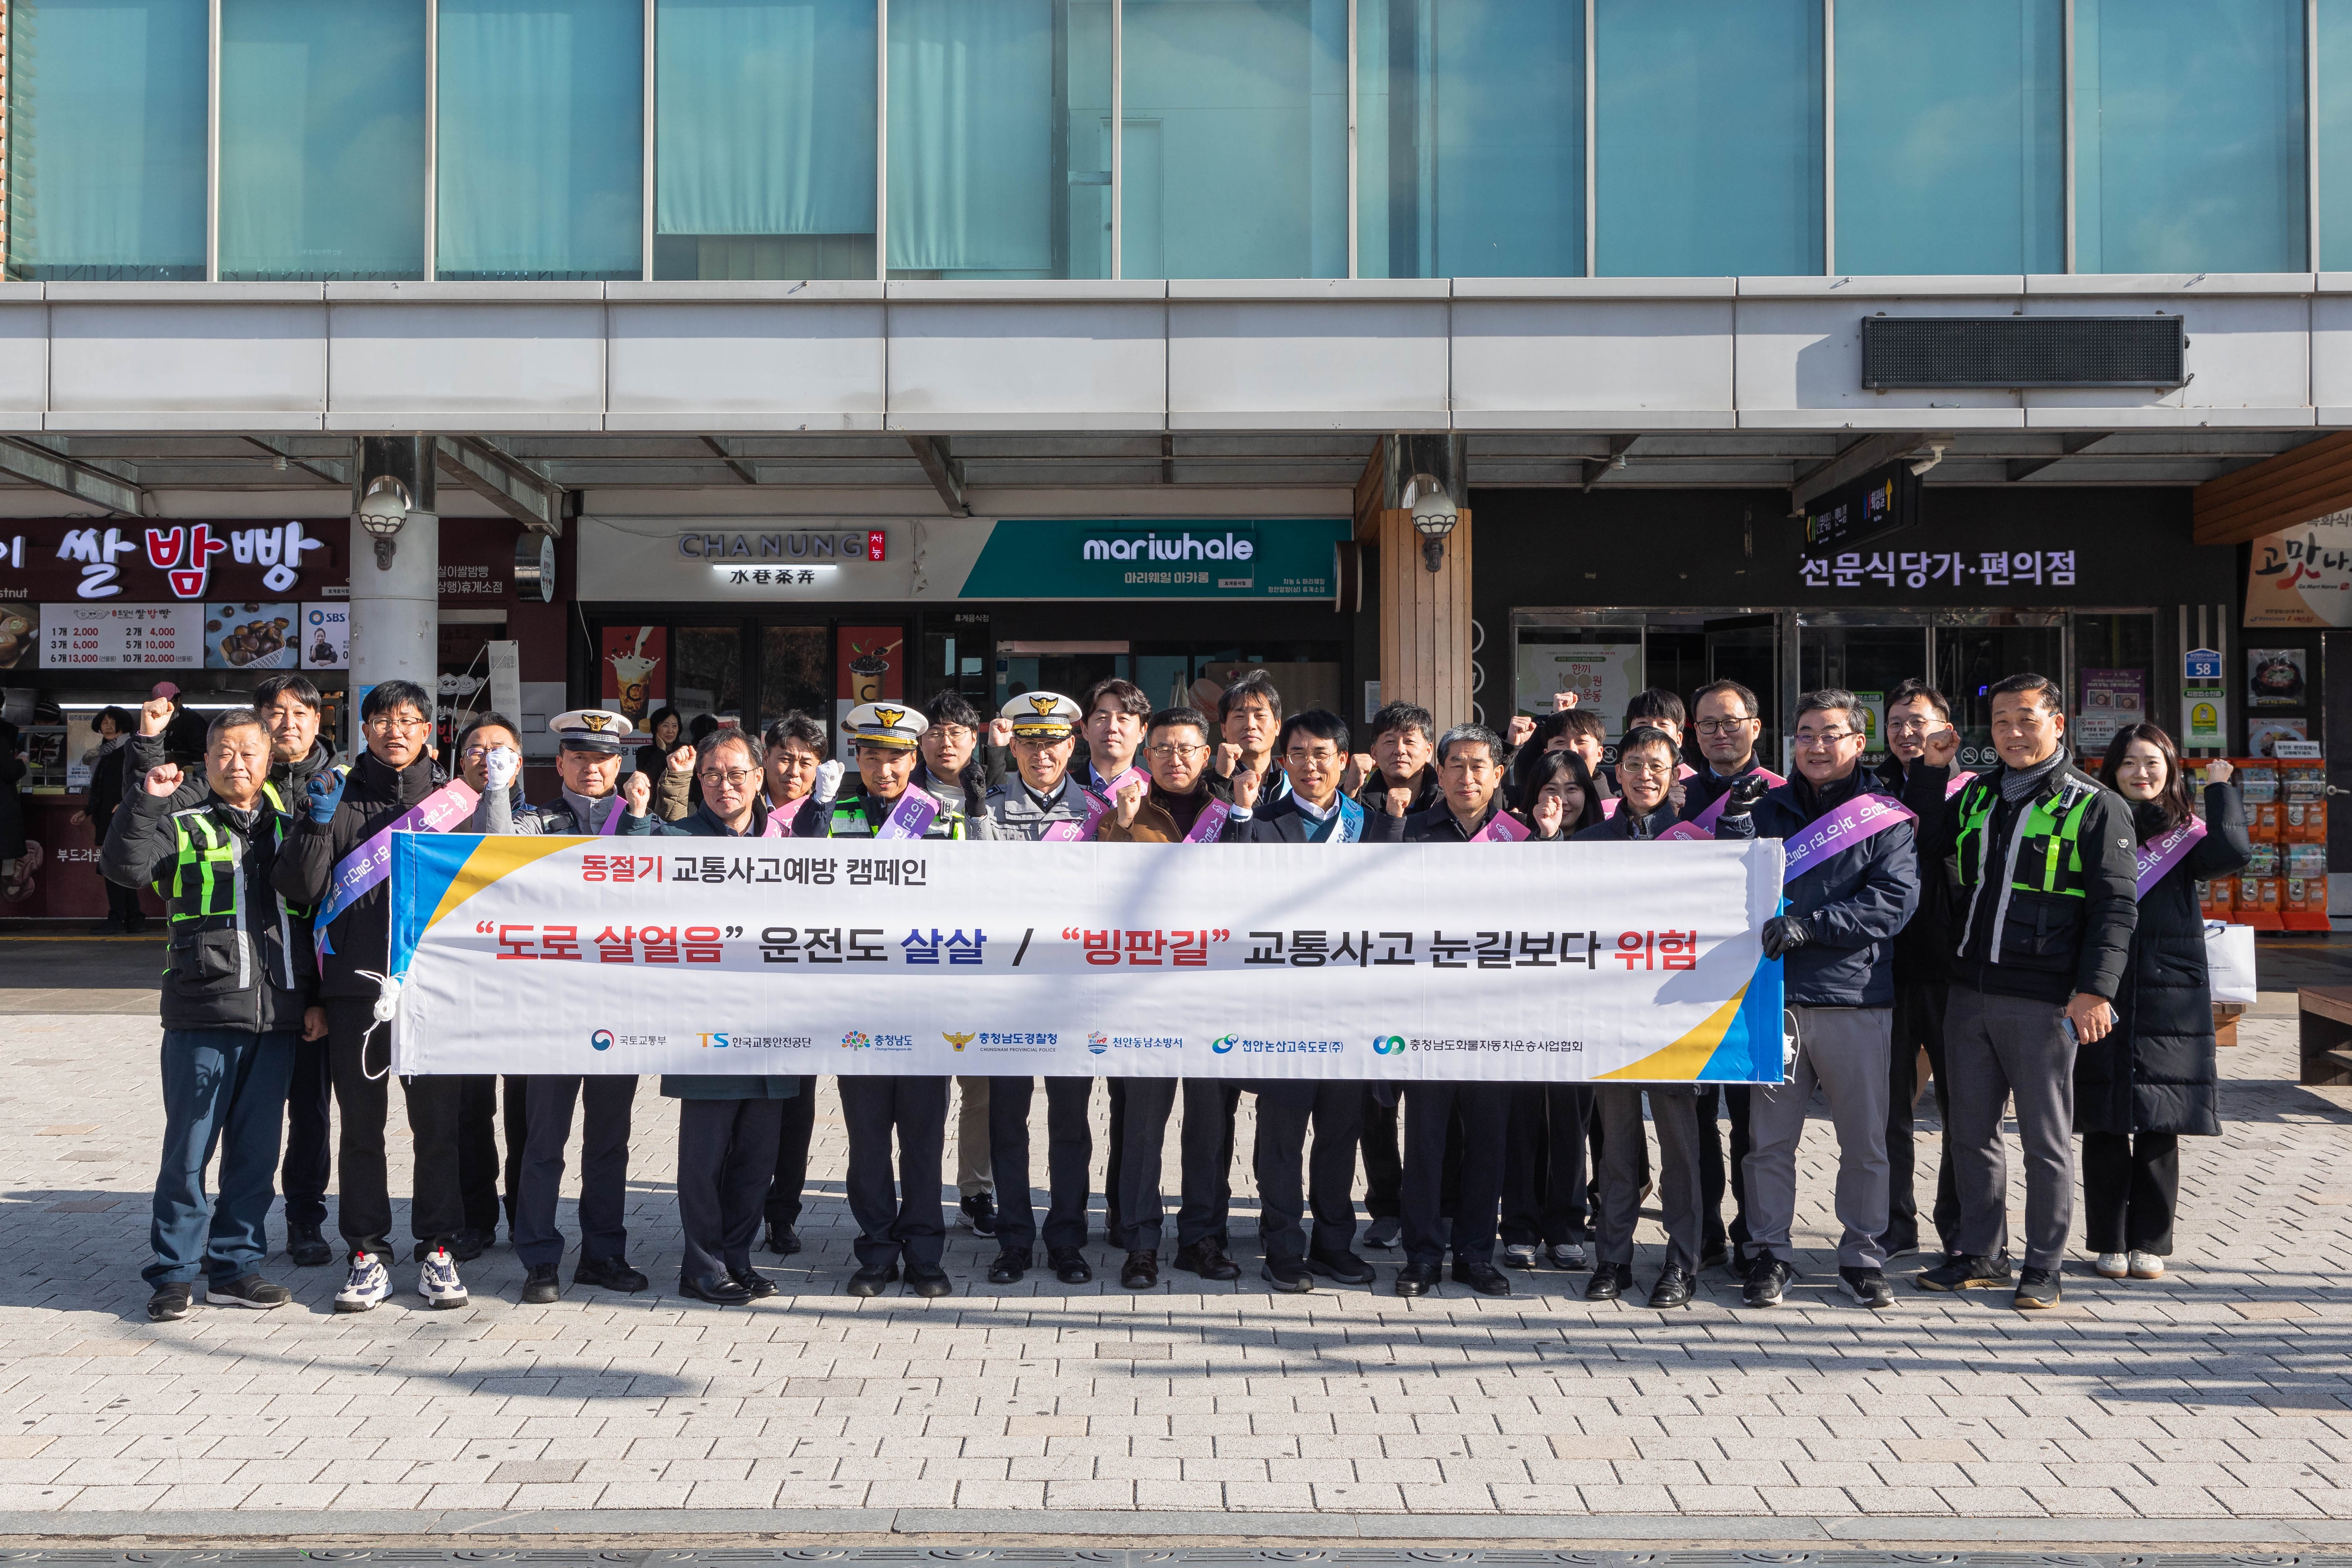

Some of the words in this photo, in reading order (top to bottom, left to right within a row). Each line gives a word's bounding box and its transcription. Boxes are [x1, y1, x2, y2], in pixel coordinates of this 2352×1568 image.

[679, 534, 863, 558] CHANUNG
[1084, 533, 1253, 560] mariwhale
[2255, 532, 2352, 590] 고맛나
[1125, 572, 1171, 583] 마리웨일
[1174, 572, 1209, 583] 마카롱
[326, 613, 345, 622] SBS
[73, 628, 99, 637] 2,000
[150, 628, 175, 637] 4,000
[73, 641, 98, 650] 6,000
[145, 641, 175, 650] 10,000
[68, 654, 98, 663] 13,000
[144, 654, 175, 663] 20,000
[1572, 663, 1591, 675] 한끼
[2196, 663, 2211, 675] 58
[1860, 800, 1901, 824] 사람이
[1809, 815, 1857, 851] 보이면
[581, 855, 663, 882] 동절기
[672, 856, 838, 885] 교통사고예방
[846, 858, 926, 886] 캠페인
[476, 921, 583, 960] “도로
[594, 926, 744, 963] 살얼음”
[759, 928, 889, 964] 운전도
[900, 929, 987, 965] 살살
[1012, 929, 1034, 967] /
[1063, 929, 1230, 967] “빙판길”
[1244, 931, 1415, 968] 교통사고
[1430, 931, 1602, 970] 눈길보다
[1615, 930, 1697, 971] 위험
[619, 1035, 667, 1046] 국토교통부
[696, 1032, 729, 1048] TS
[732, 1037, 812, 1049] 한국교통안전공단
[874, 1035, 913, 1045] 충청남도
[979, 1032, 1058, 1045] 충청남도경찰청
[1112, 1037, 1183, 1049] 천안동남소방서
[1242, 1039, 1344, 1053] 천안논산고속도로(주)
[1410, 1039, 1583, 1053] 충청남도화물자동차운송사업협회
